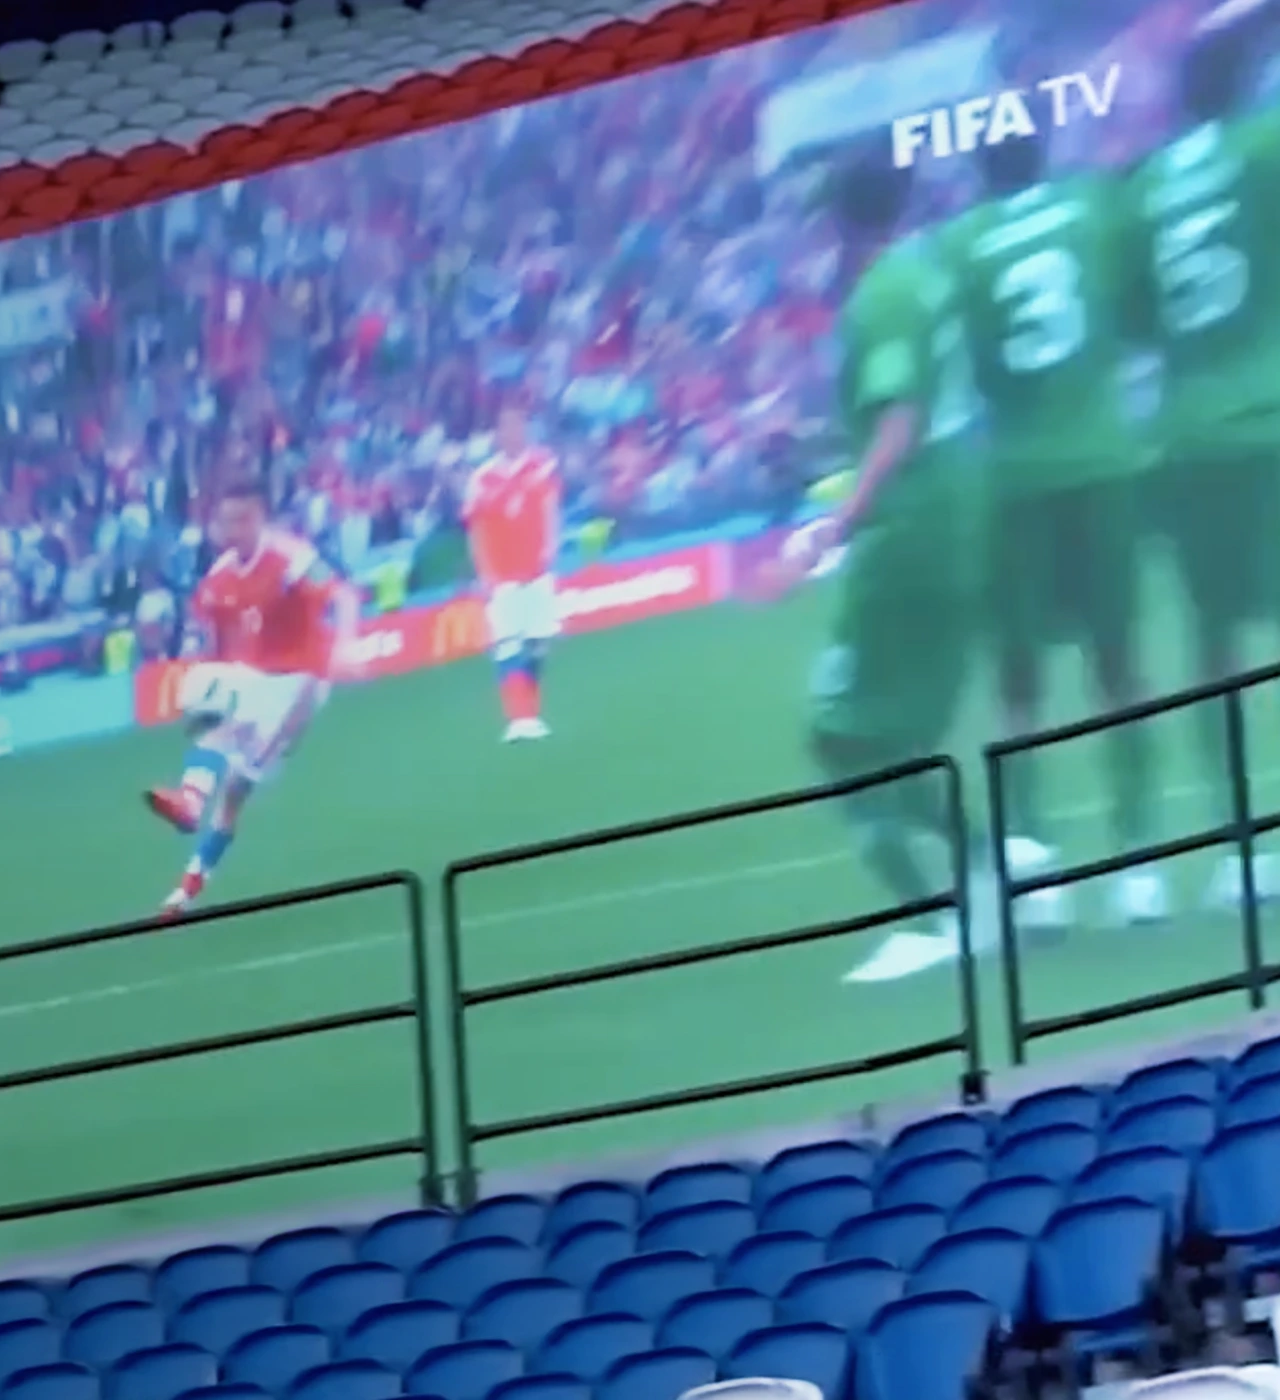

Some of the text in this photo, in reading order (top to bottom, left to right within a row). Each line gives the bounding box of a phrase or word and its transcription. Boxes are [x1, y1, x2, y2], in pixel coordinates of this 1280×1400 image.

[891, 63, 1122, 168] FIFA TV
[991, 248, 1087, 373] 3
